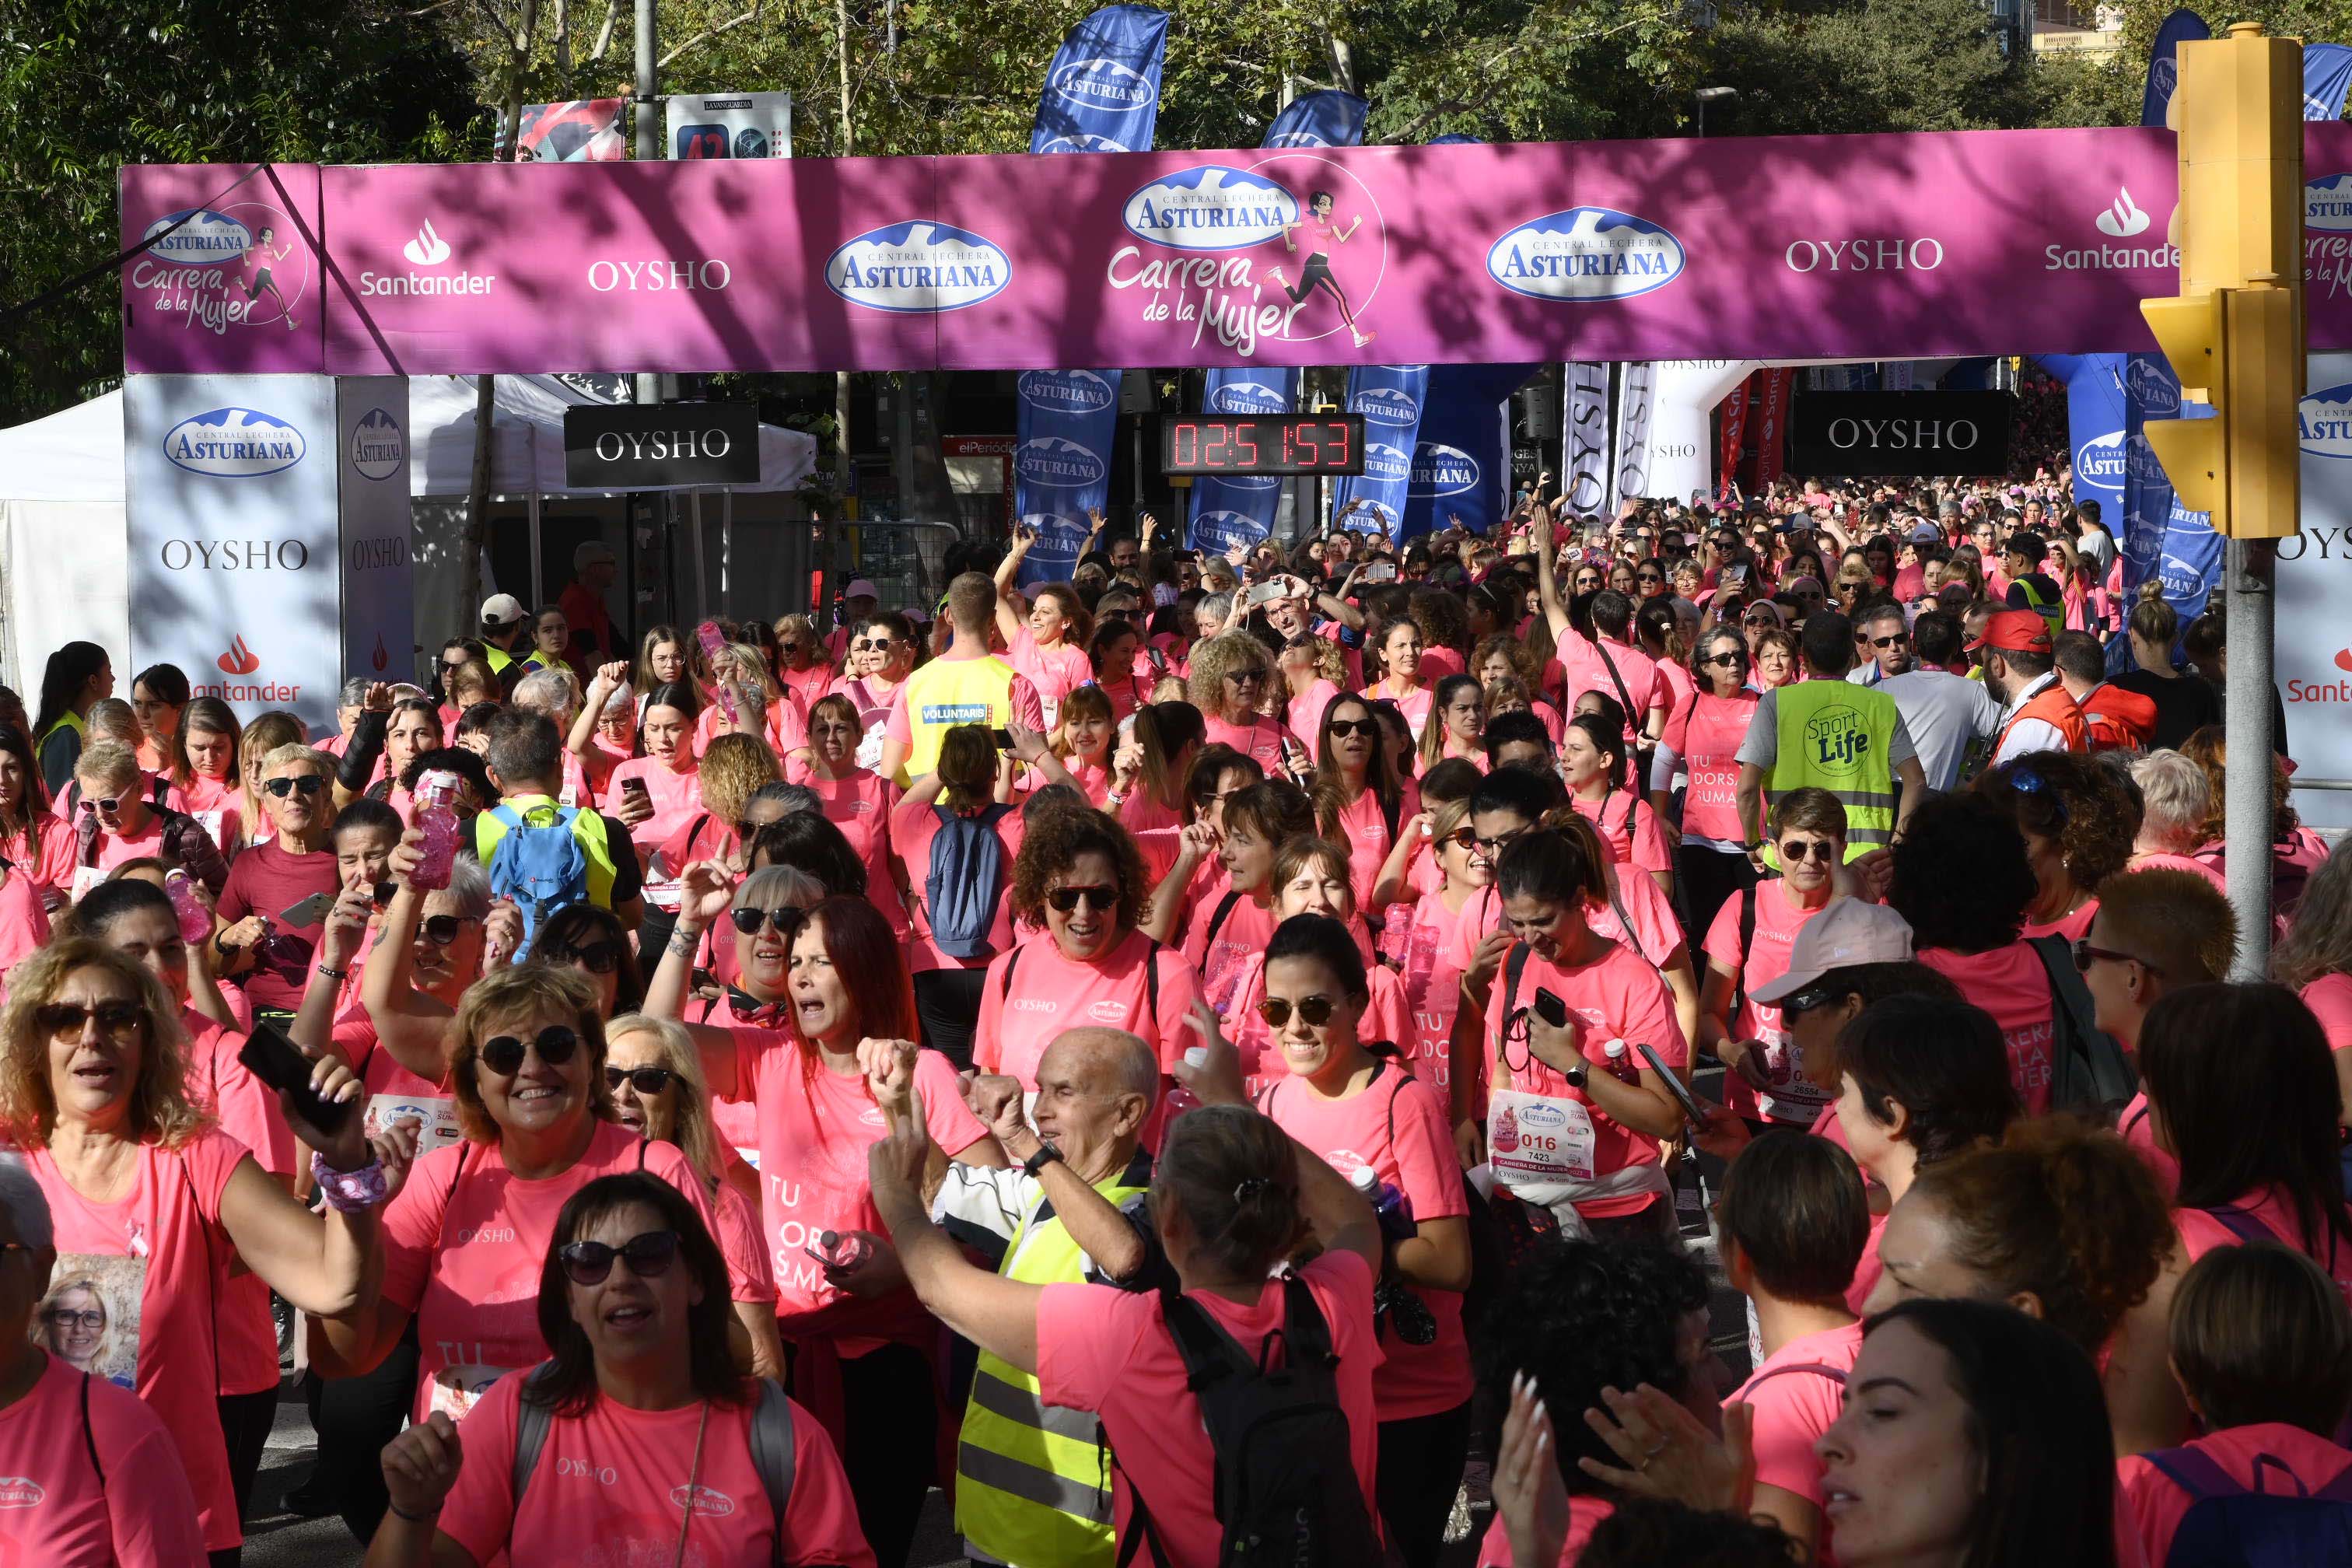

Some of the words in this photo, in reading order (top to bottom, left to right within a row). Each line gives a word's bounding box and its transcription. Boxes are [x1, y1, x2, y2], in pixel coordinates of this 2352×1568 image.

[1061, 71, 1145, 103] ASTURIANA
[1163, 195, 1219, 204] CENTRAL
[1224, 194, 1280, 202] LECHERA
[1136, 198, 1284, 229] ASTURIANA
[868, 253, 926, 261] CENTRAL
[1533, 240, 1594, 250] CENTRAL
[1601, 238, 1663, 248] LECHERA
[1786, 238, 1944, 272] OYSHO
[2045, 243, 2181, 270] Santande
[839, 255, 997, 289] ASTURIANA
[1107, 246, 1252, 289] Carrera
[1502, 243, 1670, 278] ASTURIANA
[132, 261, 224, 289] Carrera
[360, 271, 495, 296] Santander
[587, 260, 730, 292] OYSHO
[155, 292, 172, 311] de
[176, 290, 187, 311] la
[186, 286, 258, 335] Mujer
[1143, 292, 1170, 321] de
[1175, 289, 1195, 321] la
[1191, 283, 1307, 357] Mujer
[1025, 376, 1104, 404] ASTURIANA
[1356, 397, 1416, 421] ASTURIANA
[175, 433, 296, 460] ASTURIANA
[595, 429, 731, 461] OYSHO
[1828, 418, 1979, 450] OYSHO
[355, 435, 401, 463] ASTURIANA
[161, 539, 309, 570] OYSHO
[353, 536, 404, 572] OYSHO
[188, 681, 301, 702] antander
[2287, 679, 2352, 703] Sant
[922, 708, 985, 719] VOLUNTARIS
[1808, 711, 1858, 740] Sport
[1818, 729, 1868, 764] Life
[1692, 755, 1710, 768] TU
[1755, 929, 1792, 942] OYSHO
[1014, 998, 1057, 1013] OYSHO
[1416, 1013, 1443, 1032] TU
[1794, 1085, 1818, 1096] 26554
[1522, 1110, 1562, 1125] ASTURIANA
[1521, 1133, 1556, 1150] 016
[1500, 1160, 1528, 1169] CARRERA
[1528, 1151, 1550, 1163] 7423
[1499, 1170, 1530, 1181] OYSHO
[770, 1174, 800, 1207] TU
[458, 1227, 515, 1243] OYSHO
